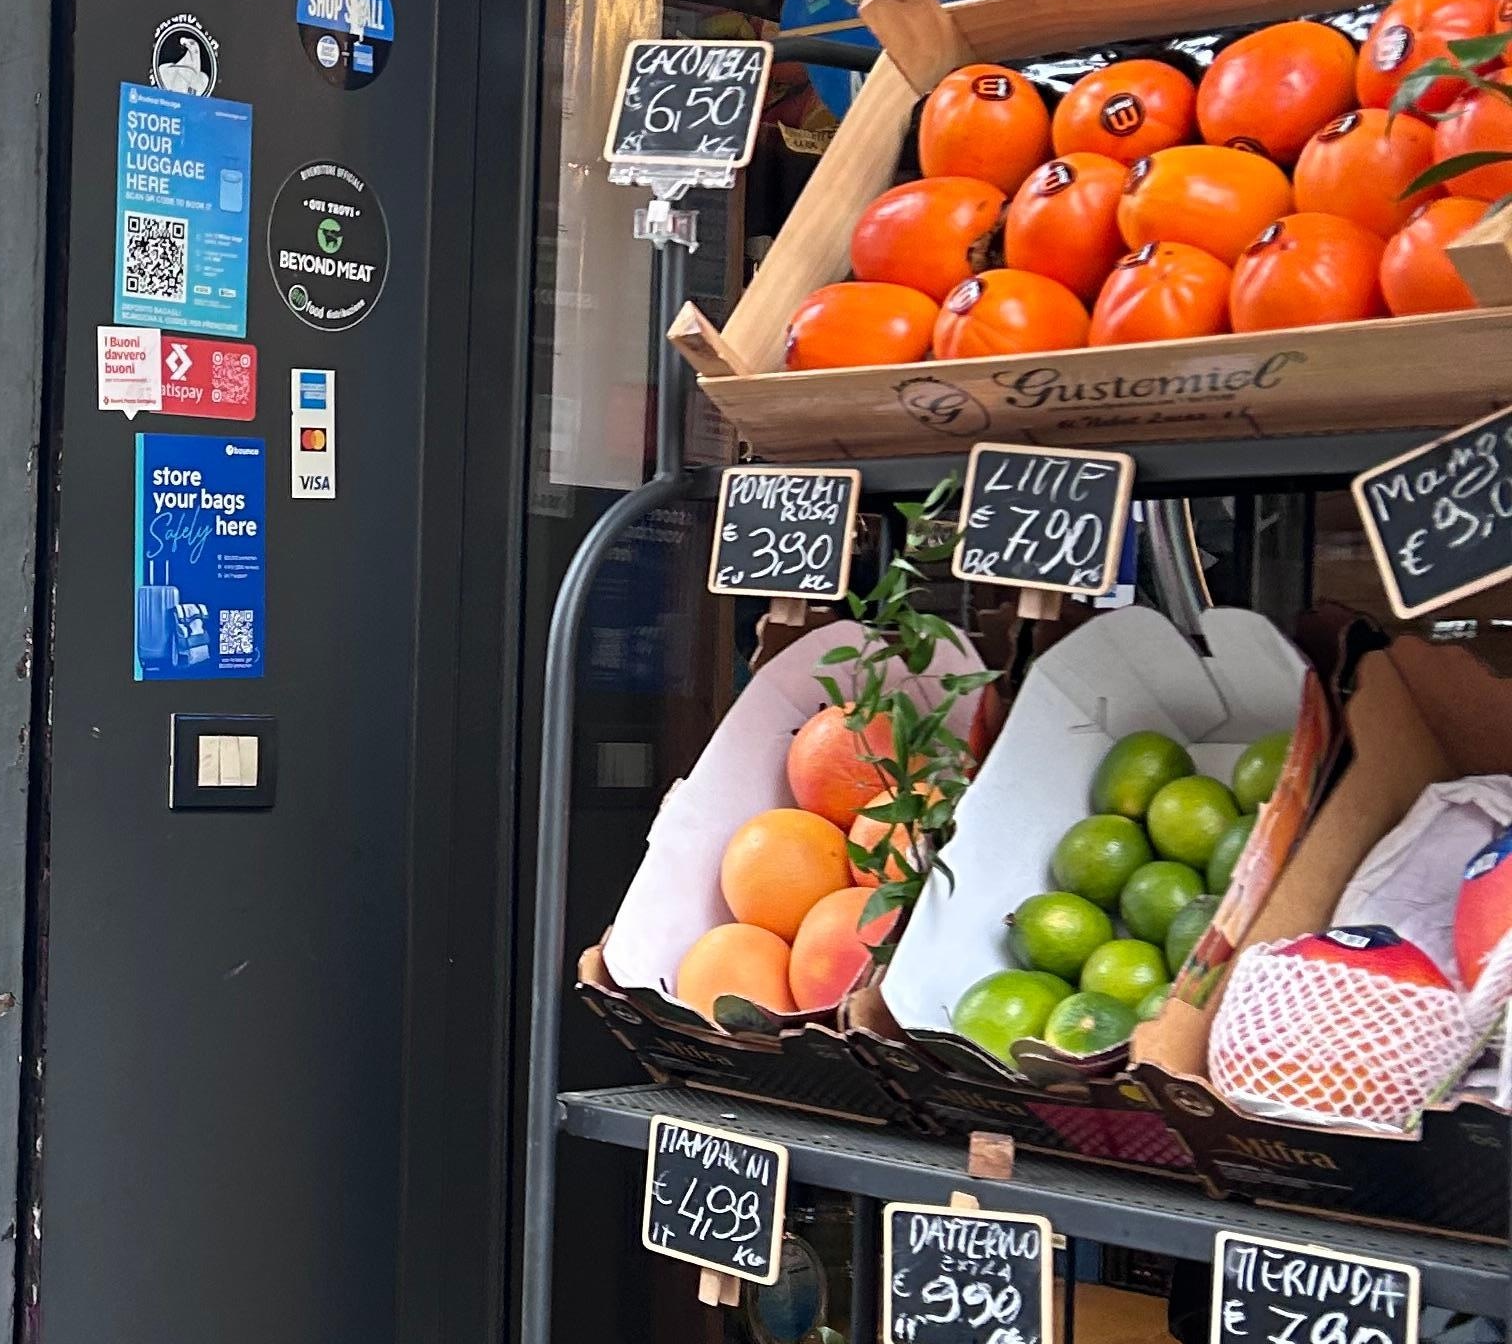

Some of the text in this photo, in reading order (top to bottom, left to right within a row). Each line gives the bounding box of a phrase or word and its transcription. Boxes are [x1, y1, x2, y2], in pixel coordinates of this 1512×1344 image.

[644, 84, 746, 133] 6,50
[127, 110, 182, 136] STORE
[127, 131, 173, 155] YOUR
[126, 152, 206, 181] LUGGAGE
[126, 174, 170, 195] HERE
[279, 250, 376, 283] BEYOND MEAT
[104, 350, 147, 361] davvero
[110, 336, 141, 348] Buoni
[104, 362, 136, 374] buoni
[152, 467, 202, 487] store
[299, 475, 330, 491] VISA
[983, 457, 1116, 503] LIME
[152, 489, 246, 515] your bags
[780, 501, 839, 525] ROSA
[146, 506, 258, 565] Safely here
[968, 504, 1104, 575] € 7,90
[748, 527, 834, 579] 3,90
[1397, 528, 1436, 576] €
[651, 1170, 761, 1241] € 4,99
[651, 1221, 678, 1247] IT
[892, 1268, 912, 1298] €
[1222, 1299, 1249, 1335] €
